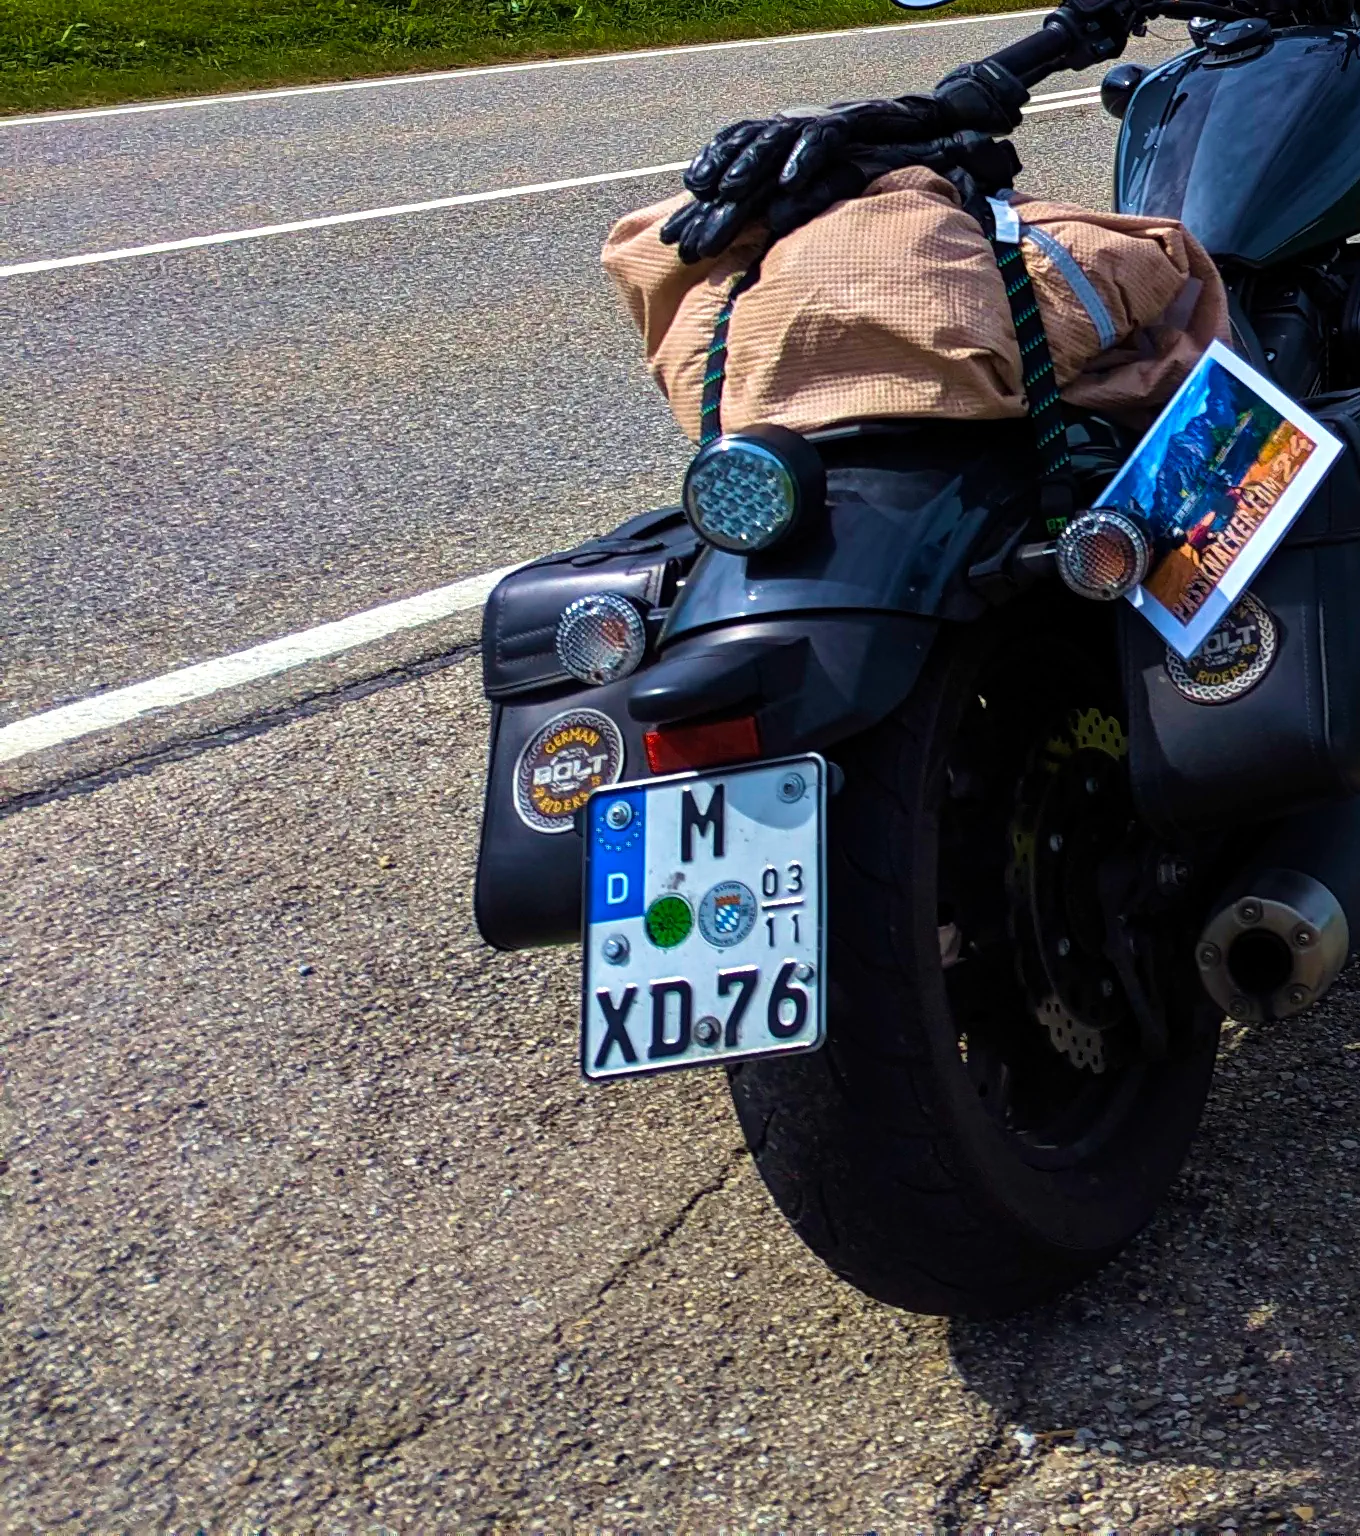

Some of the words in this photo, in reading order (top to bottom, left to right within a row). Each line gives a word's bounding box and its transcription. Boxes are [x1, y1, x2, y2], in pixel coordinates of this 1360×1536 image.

[1203, 624, 1257, 656] OLT
[1196, 660, 1249, 685] RIDERS
[544, 726, 600, 754] GERMAN
[532, 754, 609, 785] BOLT
[681, 783, 725, 863] M
[607, 872, 629, 905] D
[762, 860, 804, 898] 03
[765, 912, 801, 948] 11
[594, 976, 693, 1068] XD
[716, 958, 809, 1048] 76
